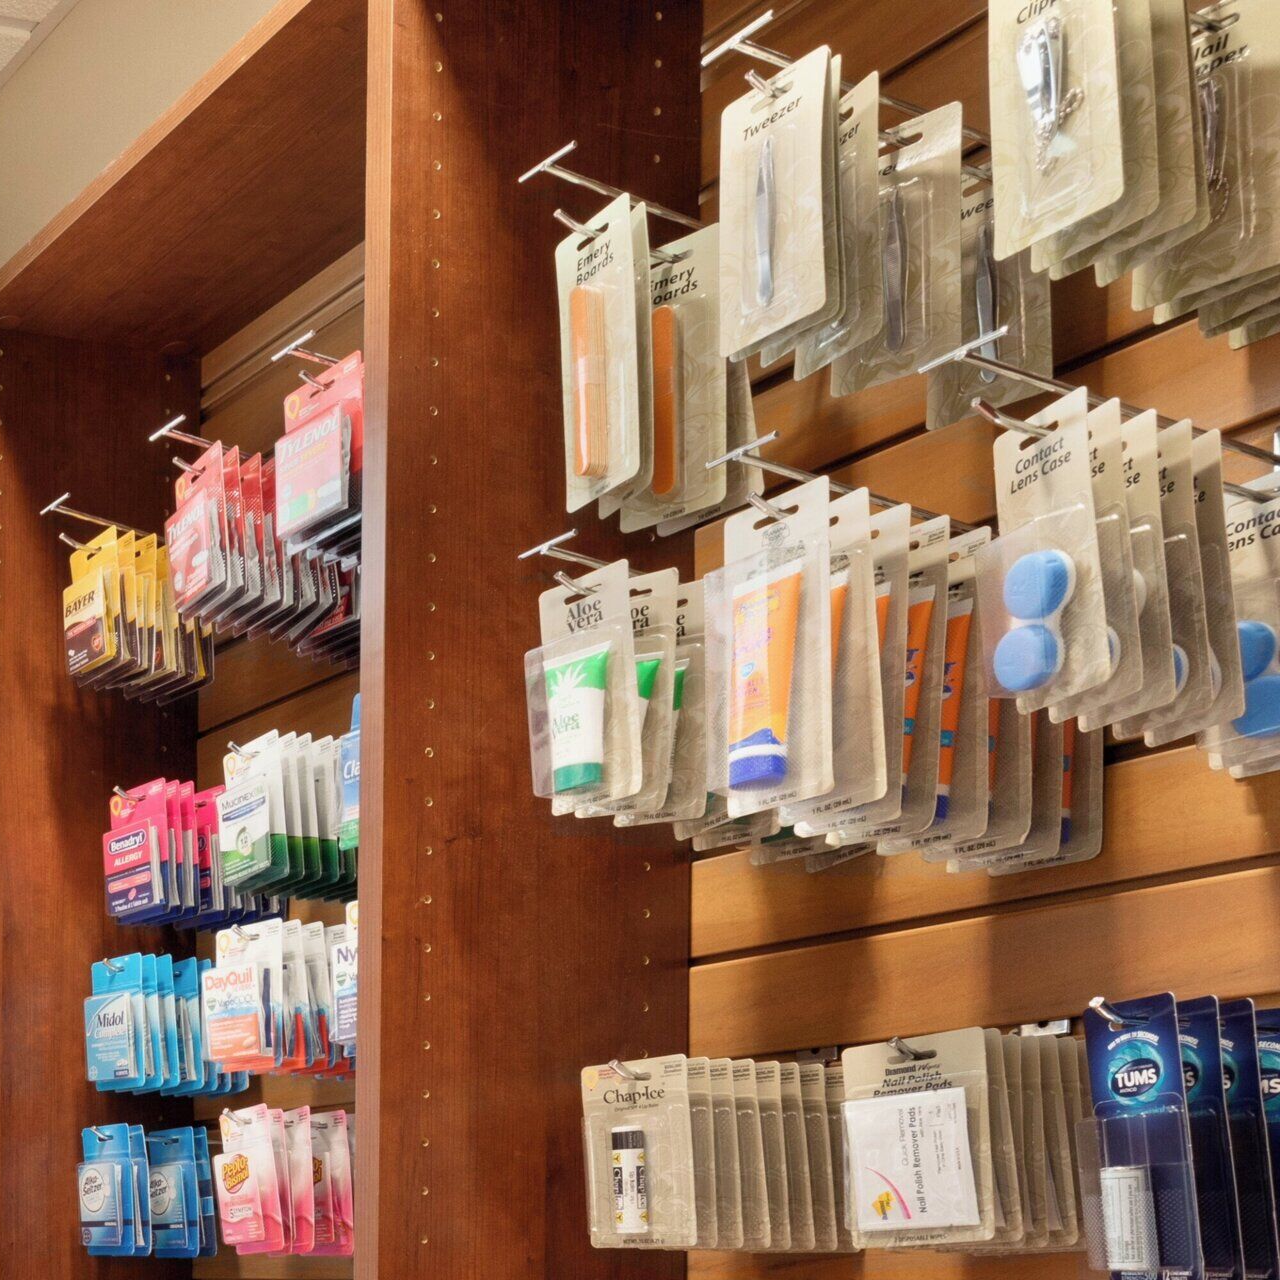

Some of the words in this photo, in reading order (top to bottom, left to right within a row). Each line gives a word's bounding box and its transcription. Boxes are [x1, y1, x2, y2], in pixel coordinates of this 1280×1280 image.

[742, 95, 804, 142] Tweezer
[576, 238, 612, 273] Emery
[576, 253, 615, 288] Boards
[278, 412, 339, 463] TYLENOL
[1015, 435, 1066, 475] Contact
[1010, 472, 1038, 496] Lens
[1041, 449, 1072, 477] Case
[167, 499, 207, 547] TYLENOL
[65, 590, 95, 618] BAYER
[566, 599, 603, 623] Aloe
[567, 608, 604, 634] vera
[110, 833, 144, 854] Benadryl
[113, 851, 143, 867] ALLERGY
[205, 971, 253, 993] DayQuil
[96, 1011, 124, 1029] Midol
[882, 1075, 906, 1089] Nail
[907, 1070, 942, 1085] Polish
[885, 1064, 917, 1077] Diamond
[1114, 1069, 1158, 1088] TUMS
[873, 1085, 923, 1098] Remover
[925, 1079, 953, 1091] Pads
[908, 1106, 917, 1128] Pads
[911, 1130, 921, 1169] Remover
[82, 1184, 104, 1197] Seltzer
[225, 1168, 250, 1191] Bismol
[916, 1169, 925, 1195] Polish
[919, 1195, 928, 1213] Nail
